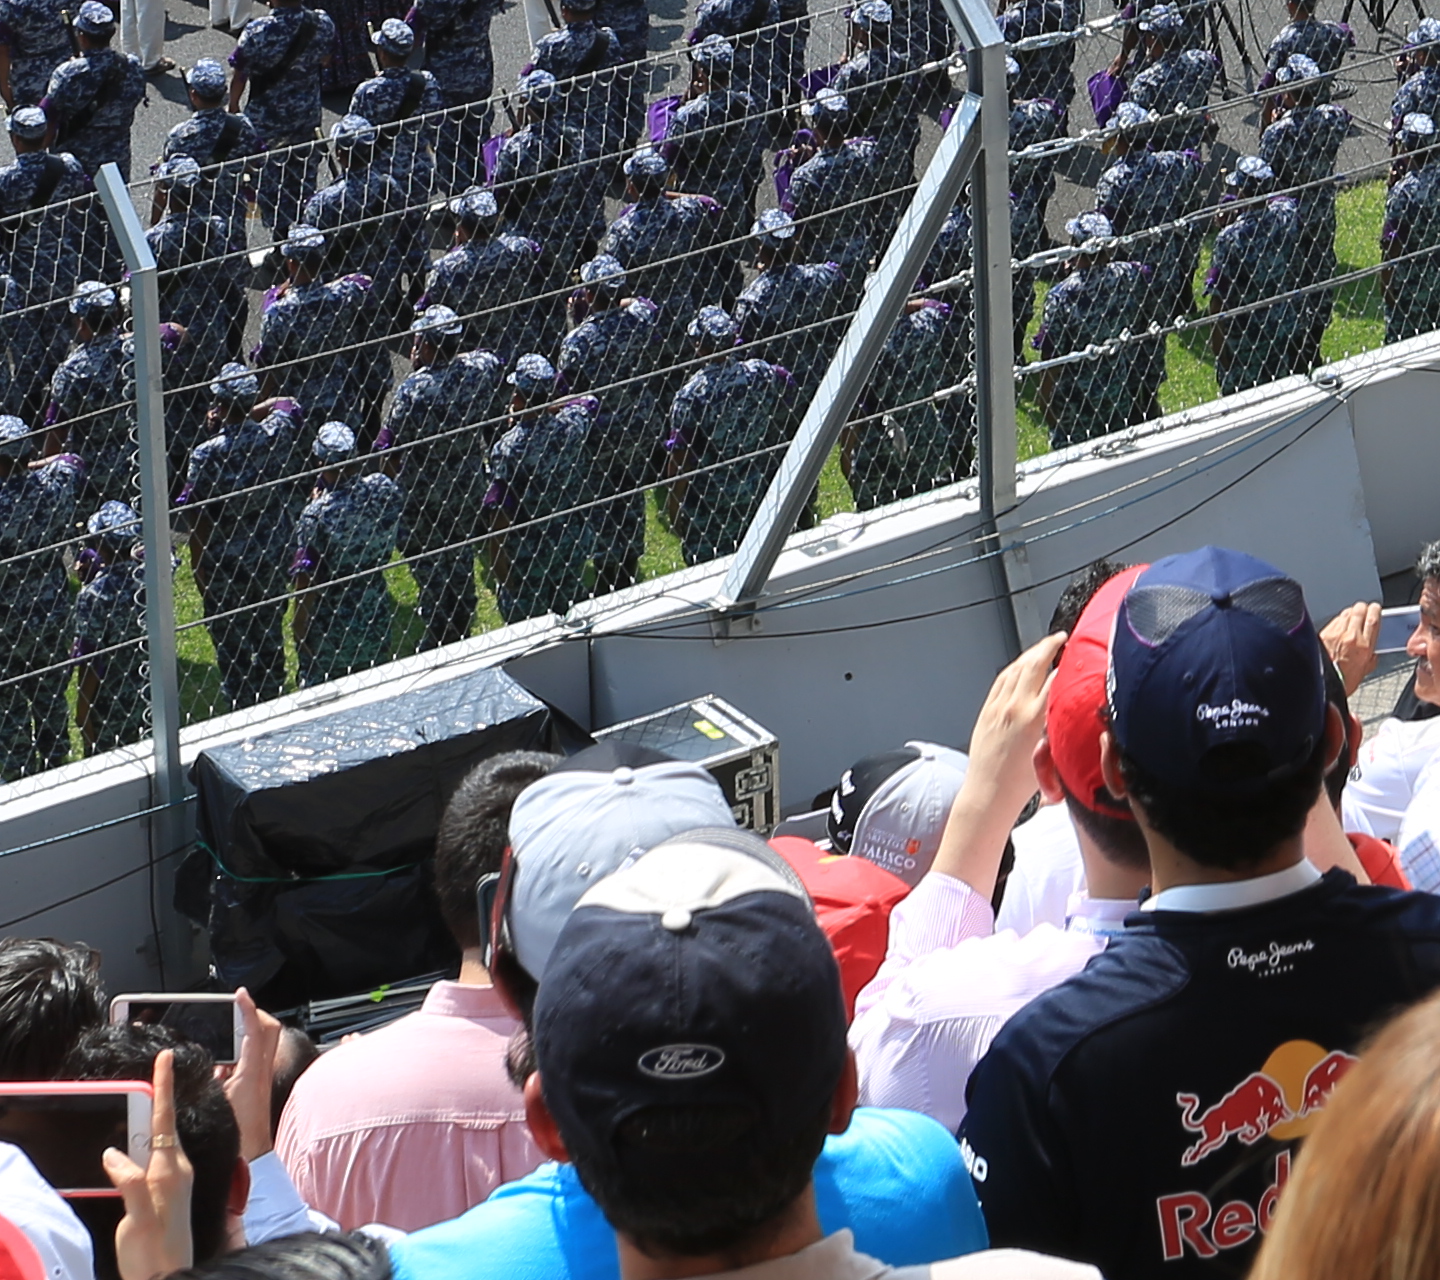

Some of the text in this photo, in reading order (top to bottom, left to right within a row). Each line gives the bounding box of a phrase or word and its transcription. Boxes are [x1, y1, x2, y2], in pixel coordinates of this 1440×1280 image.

[1196, 699, 1270, 721] Pepe Jeans
[1215, 719, 1259, 730] LONDON
[861, 842, 917, 870] JALISCO
[1227, 939, 1315, 972] Pepe Jeans
[653, 1046, 709, 1076] Ford
[1156, 1149, 1299, 1261] Red
